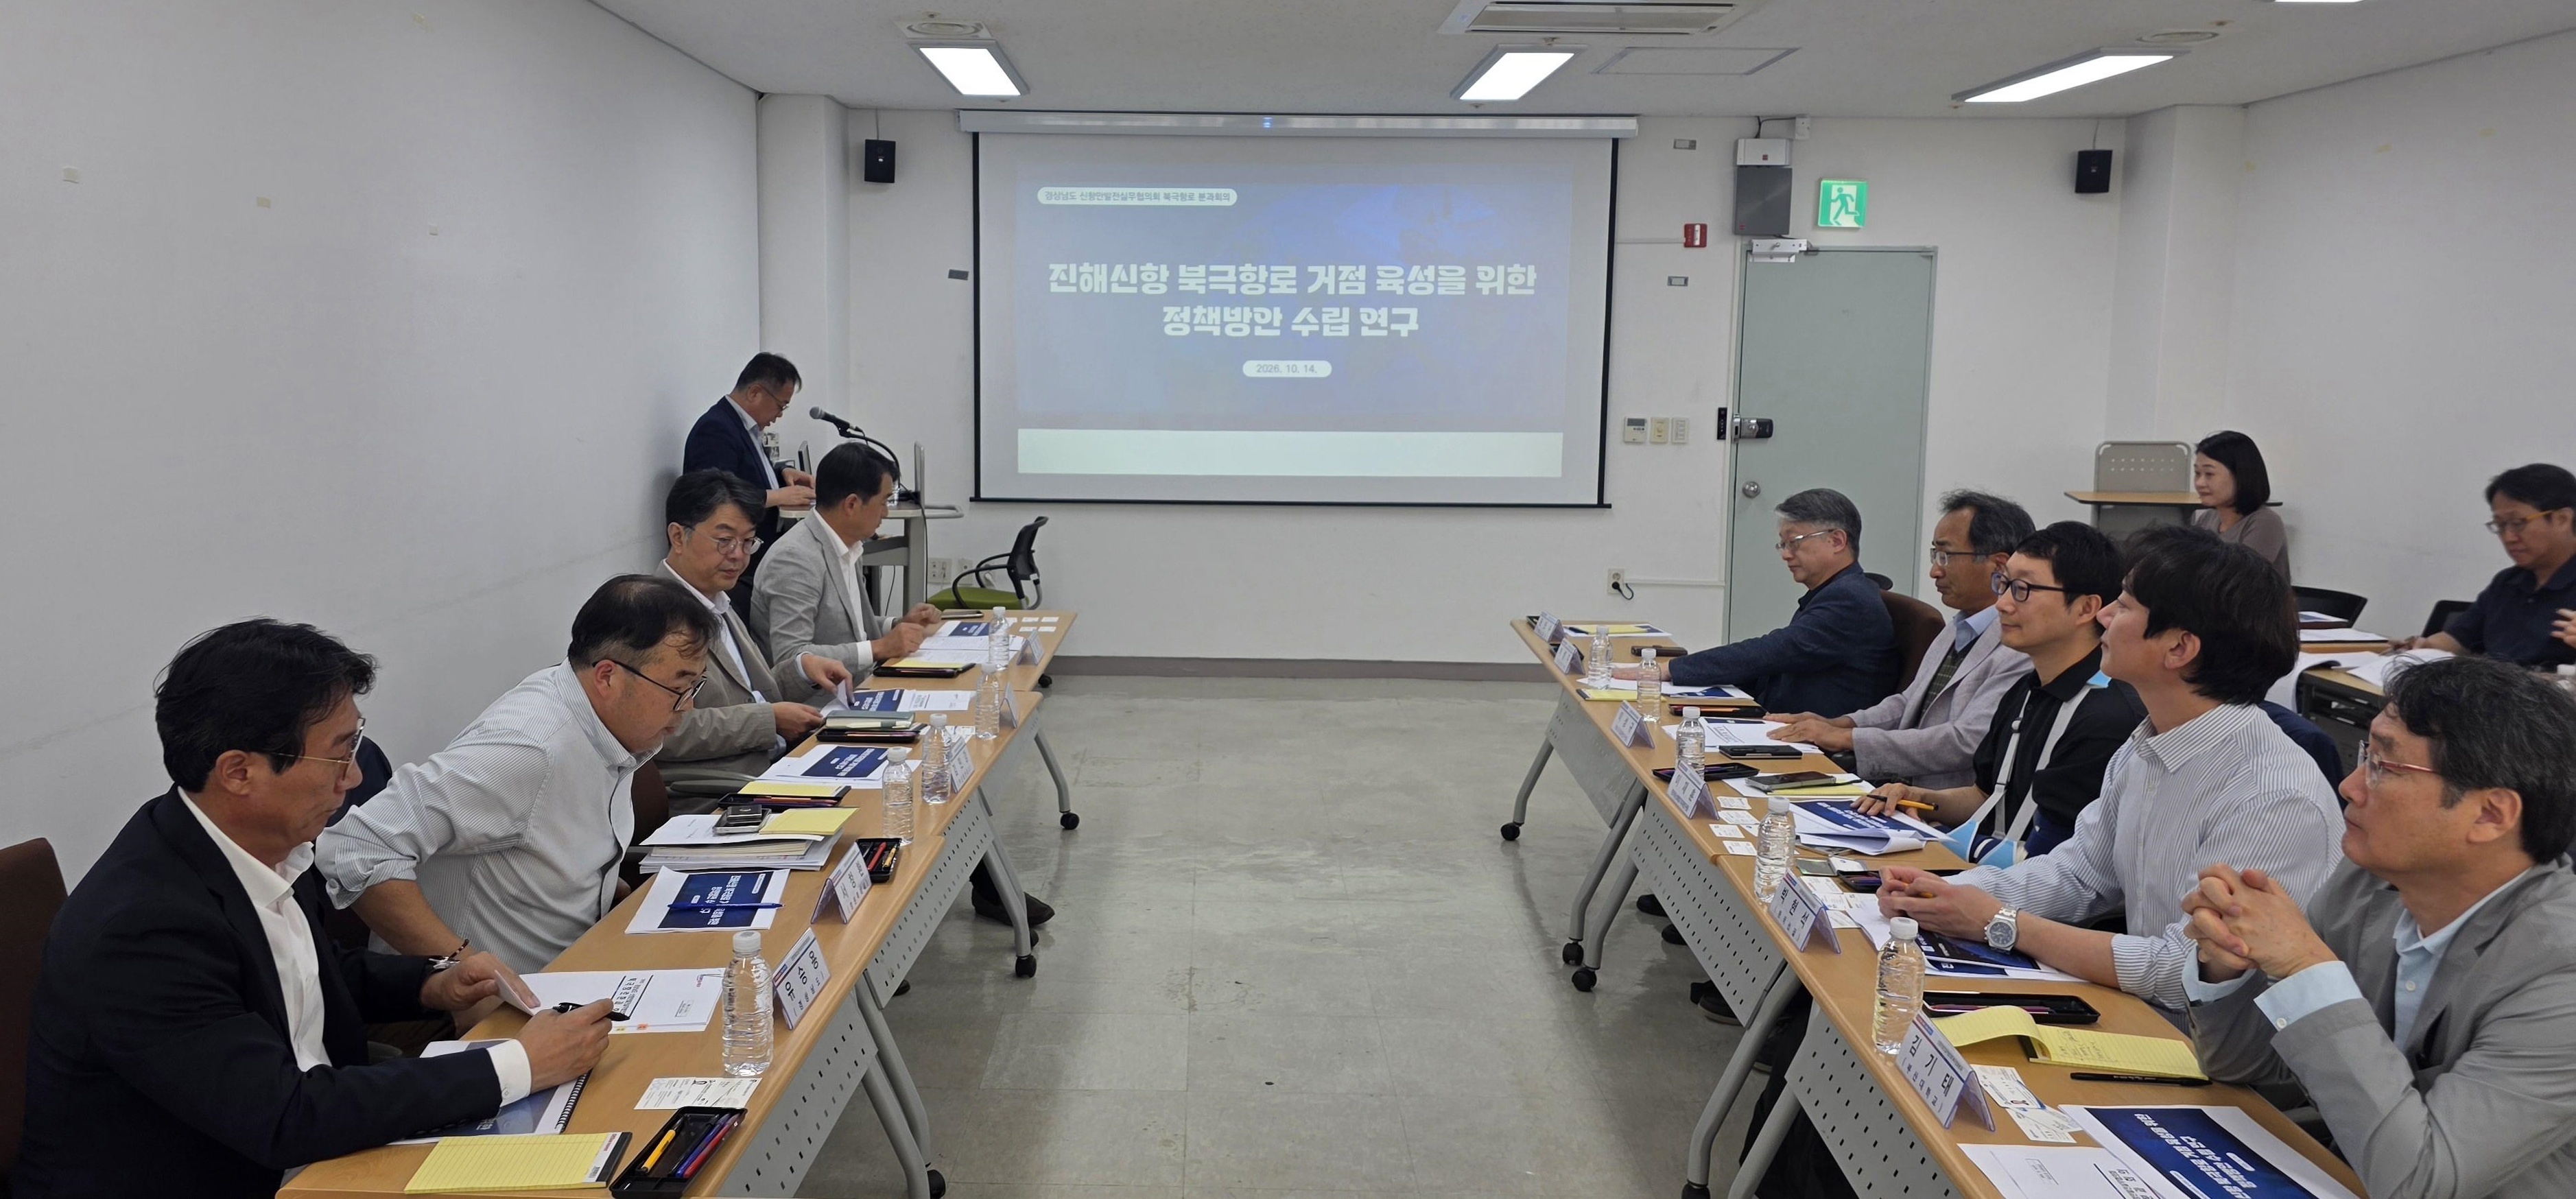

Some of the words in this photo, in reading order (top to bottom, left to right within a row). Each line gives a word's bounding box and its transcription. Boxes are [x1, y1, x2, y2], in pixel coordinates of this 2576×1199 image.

[1044, 191, 1077, 201] 경상남도
[1049, 262, 1170, 295] 진해신항
[1178, 263, 1298, 296] 북극항로
[1307, 265, 1366, 296] 거점
[1376, 265, 1467, 296] 육성을
[1476, 263, 1537, 296] 위한
[1163, 305, 1283, 337] 정책방안
[1291, 307, 1350, 337] 수립
[1359, 307, 1419, 337] 연구
[1256, 364, 1282, 374] 2026.
[1286, 364, 1300, 374] 10.
[1304, 364, 1318, 375] 14.
[1909, 1034, 1954, 1097] 김기태
